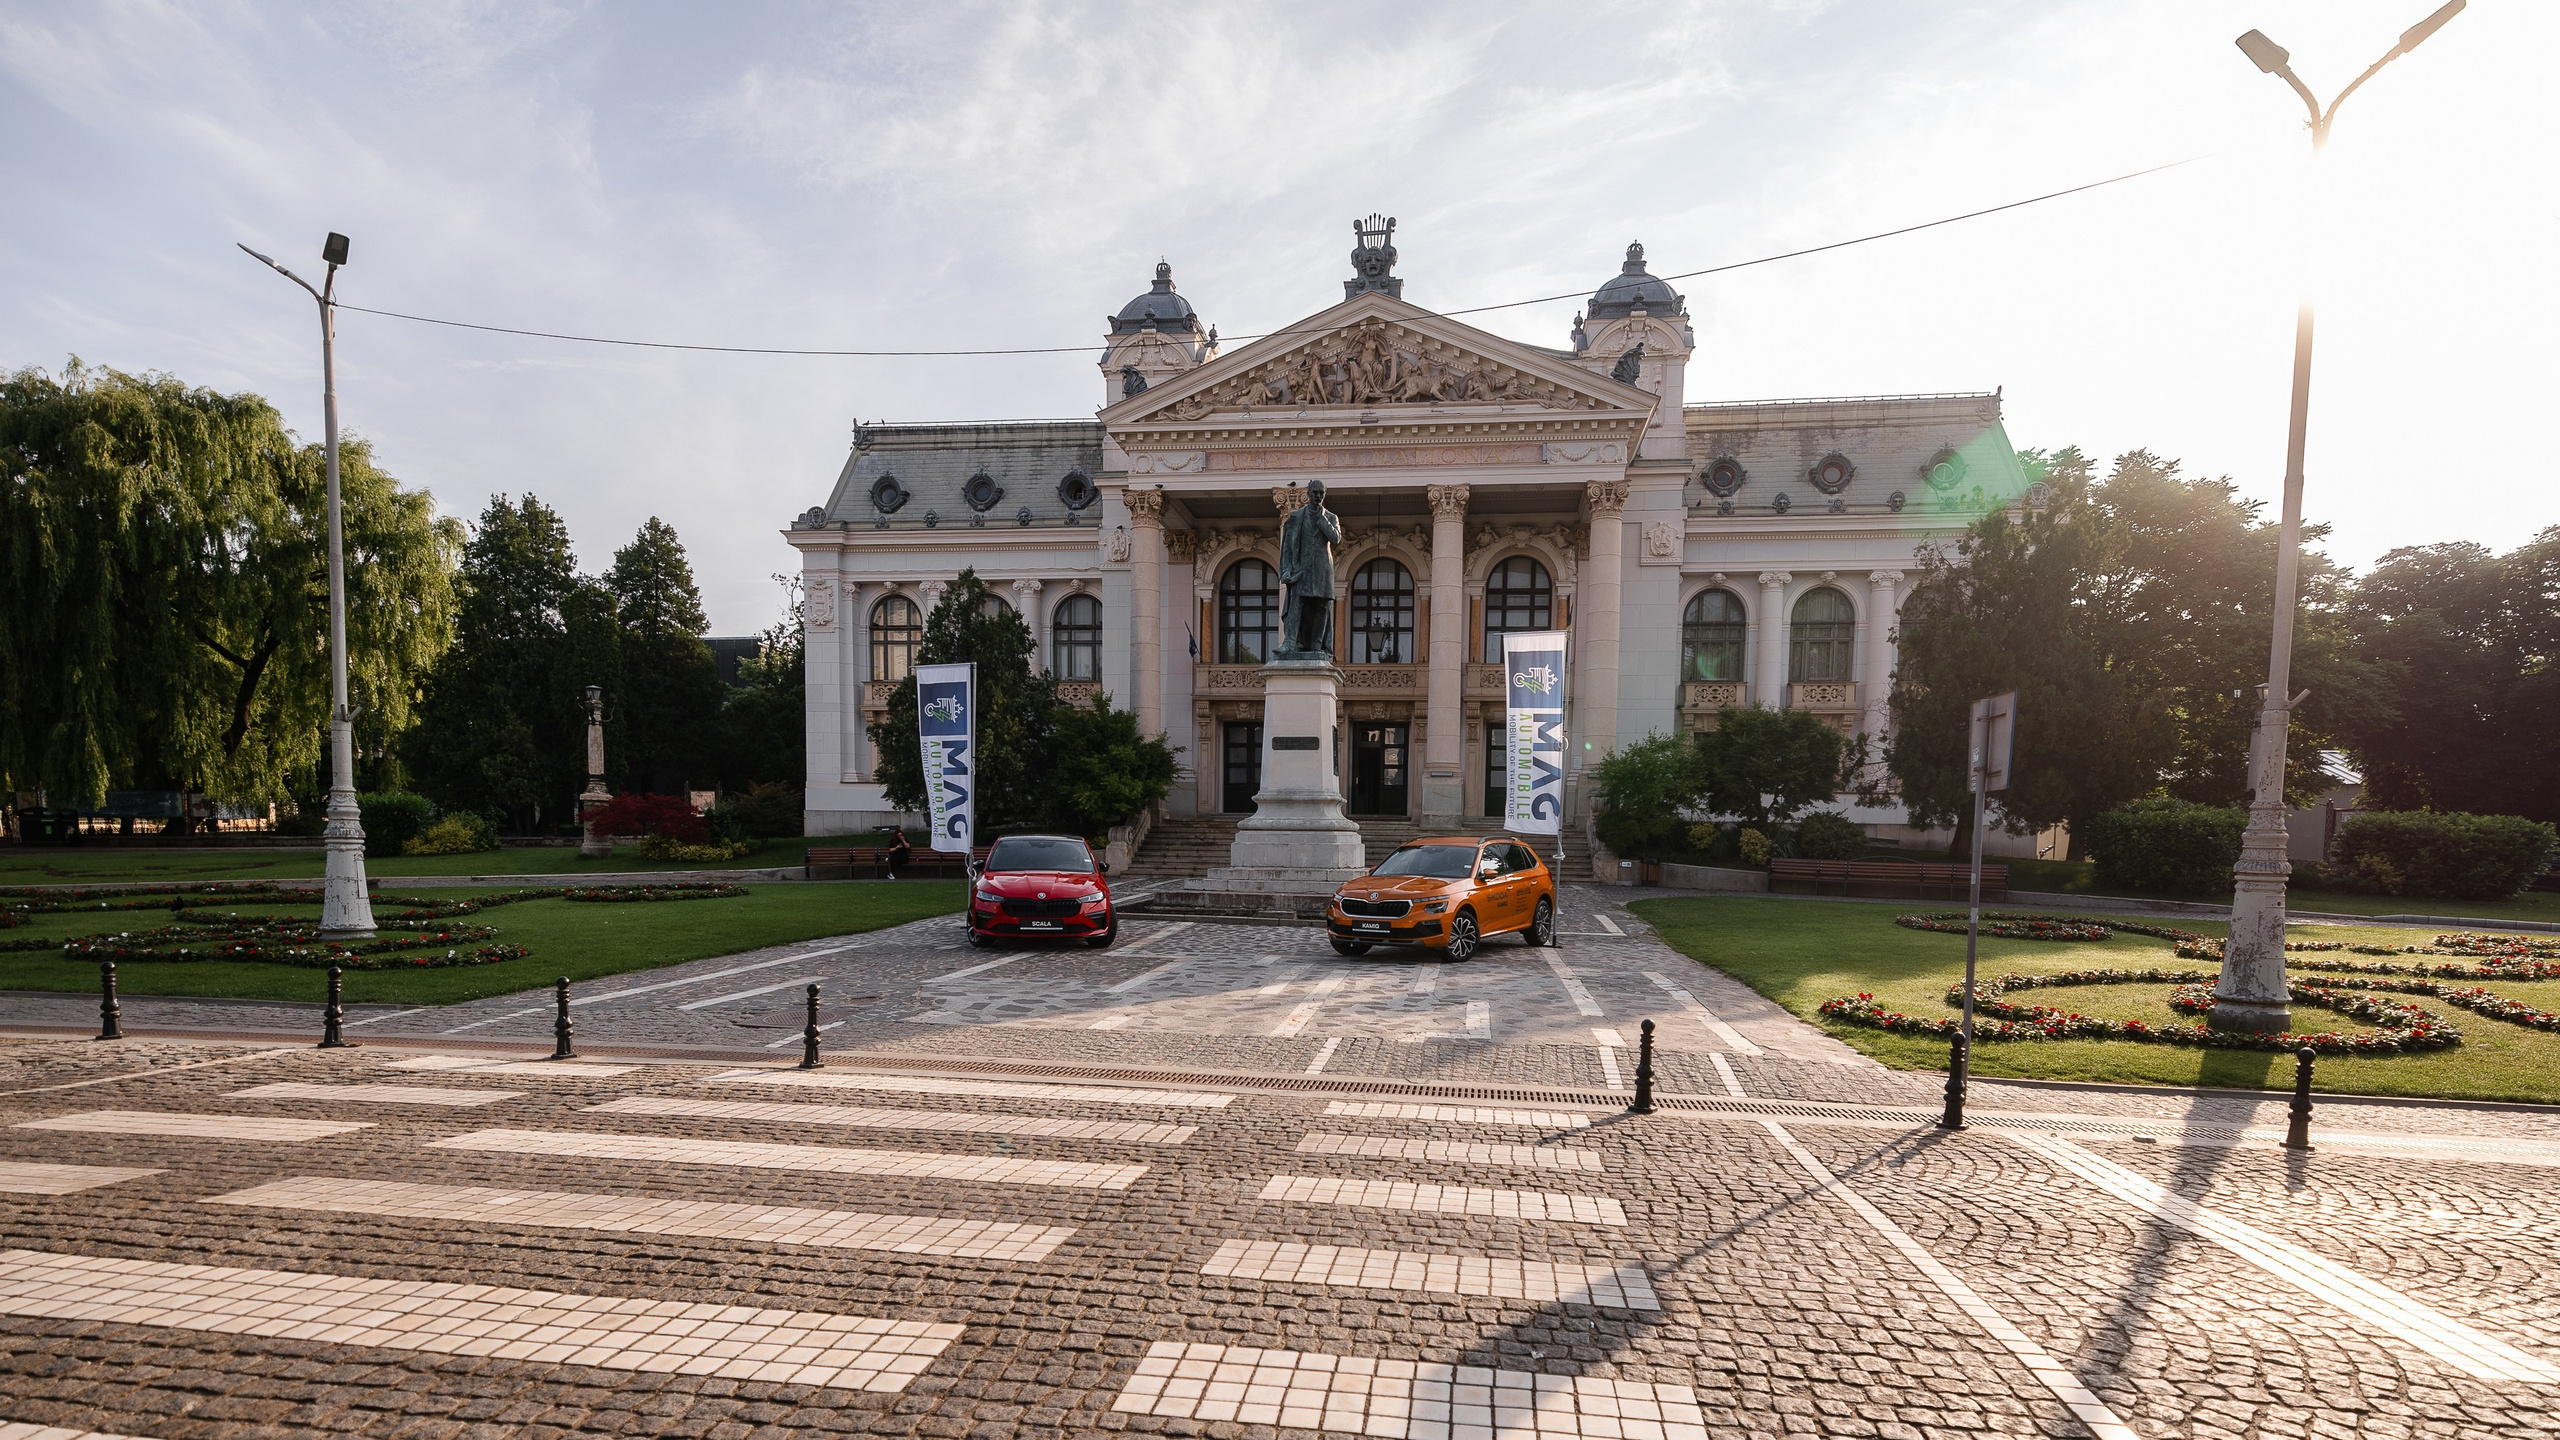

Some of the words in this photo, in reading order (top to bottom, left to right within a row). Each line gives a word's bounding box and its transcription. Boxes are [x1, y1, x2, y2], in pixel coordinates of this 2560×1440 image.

[1231, 450, 1358, 468] TEATRUL
[1508, 714, 1517, 754] MOBILITY
[1509, 755, 1516, 767] OF
[1517, 713, 1532, 819] AUTOMOBILE
[1531, 713, 1562, 820] MAG
[942, 740, 968, 839] MAG
